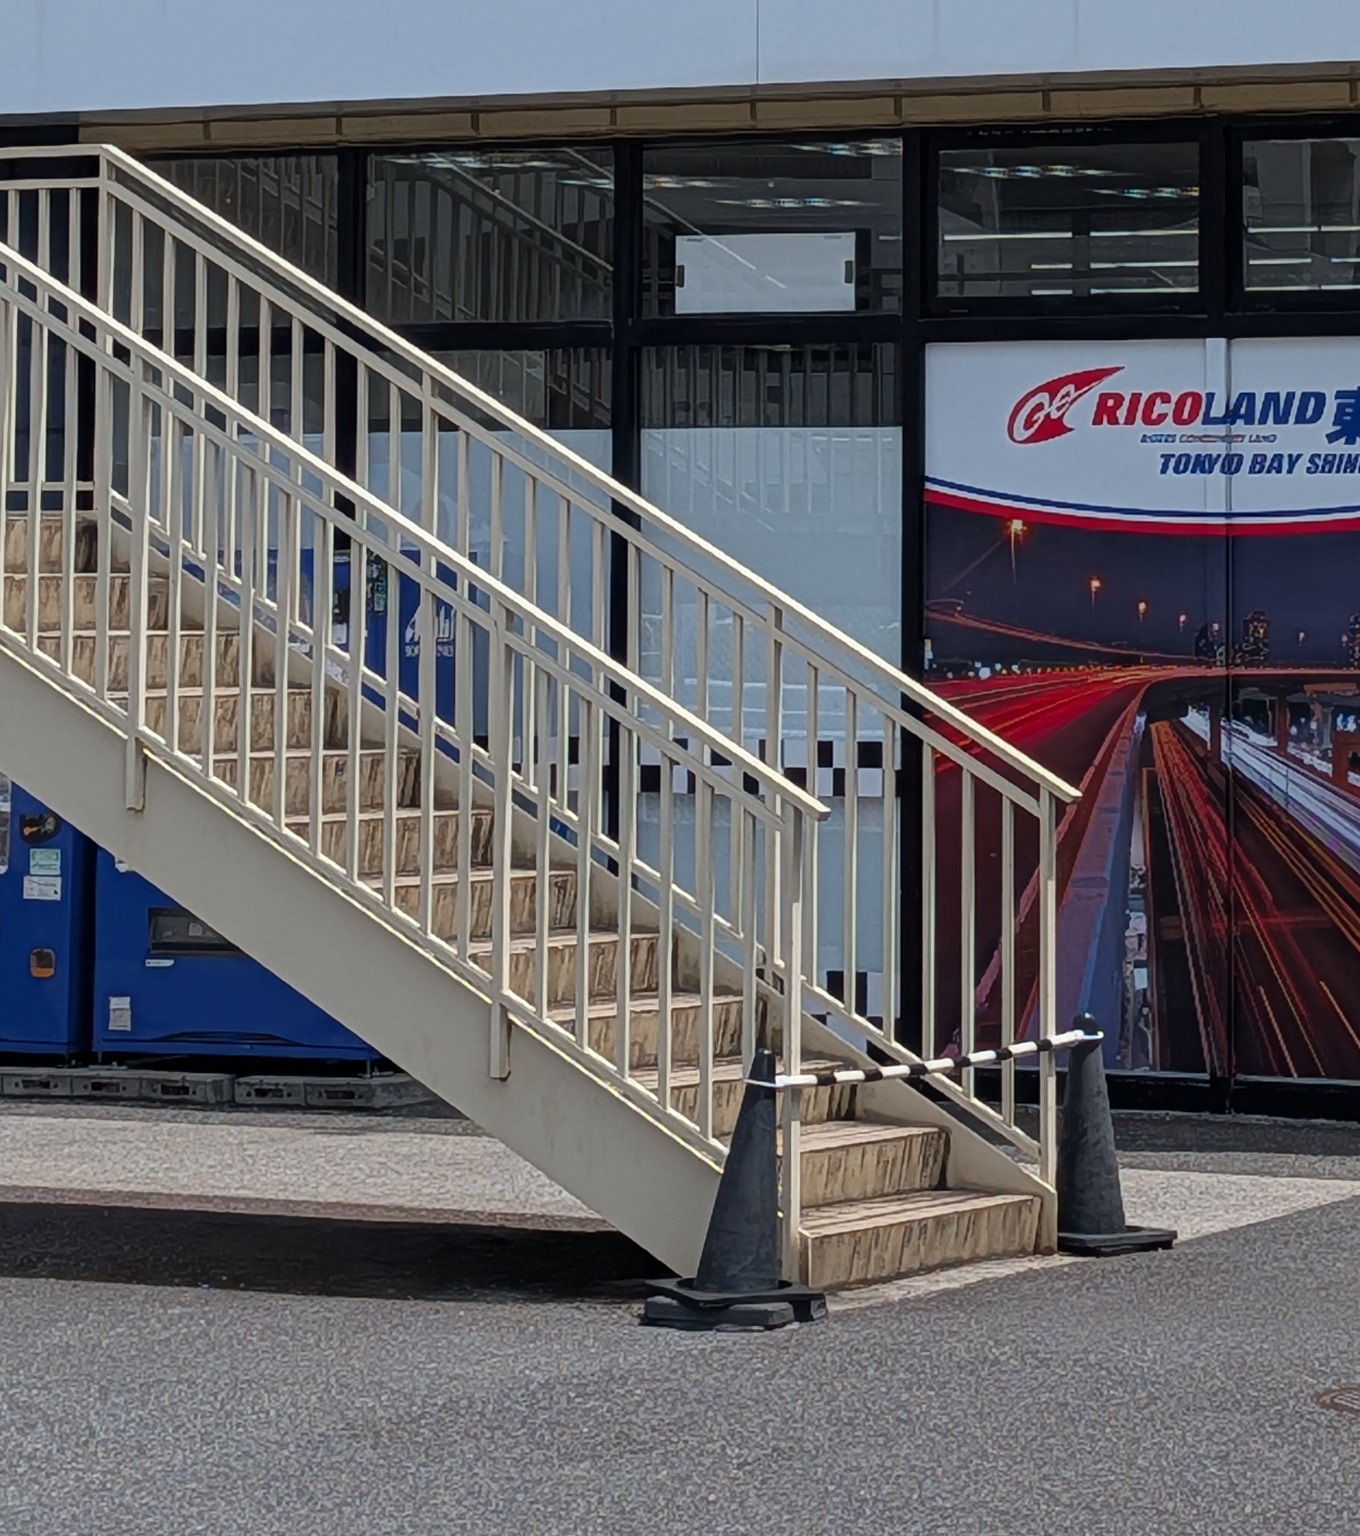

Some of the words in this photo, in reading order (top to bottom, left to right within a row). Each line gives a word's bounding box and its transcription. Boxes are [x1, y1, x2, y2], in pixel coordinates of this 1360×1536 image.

[1091, 391, 1326, 425] RICOLAND
[1159, 452, 1245, 476] TOKYO
[1247, 452, 1304, 476] BAY
